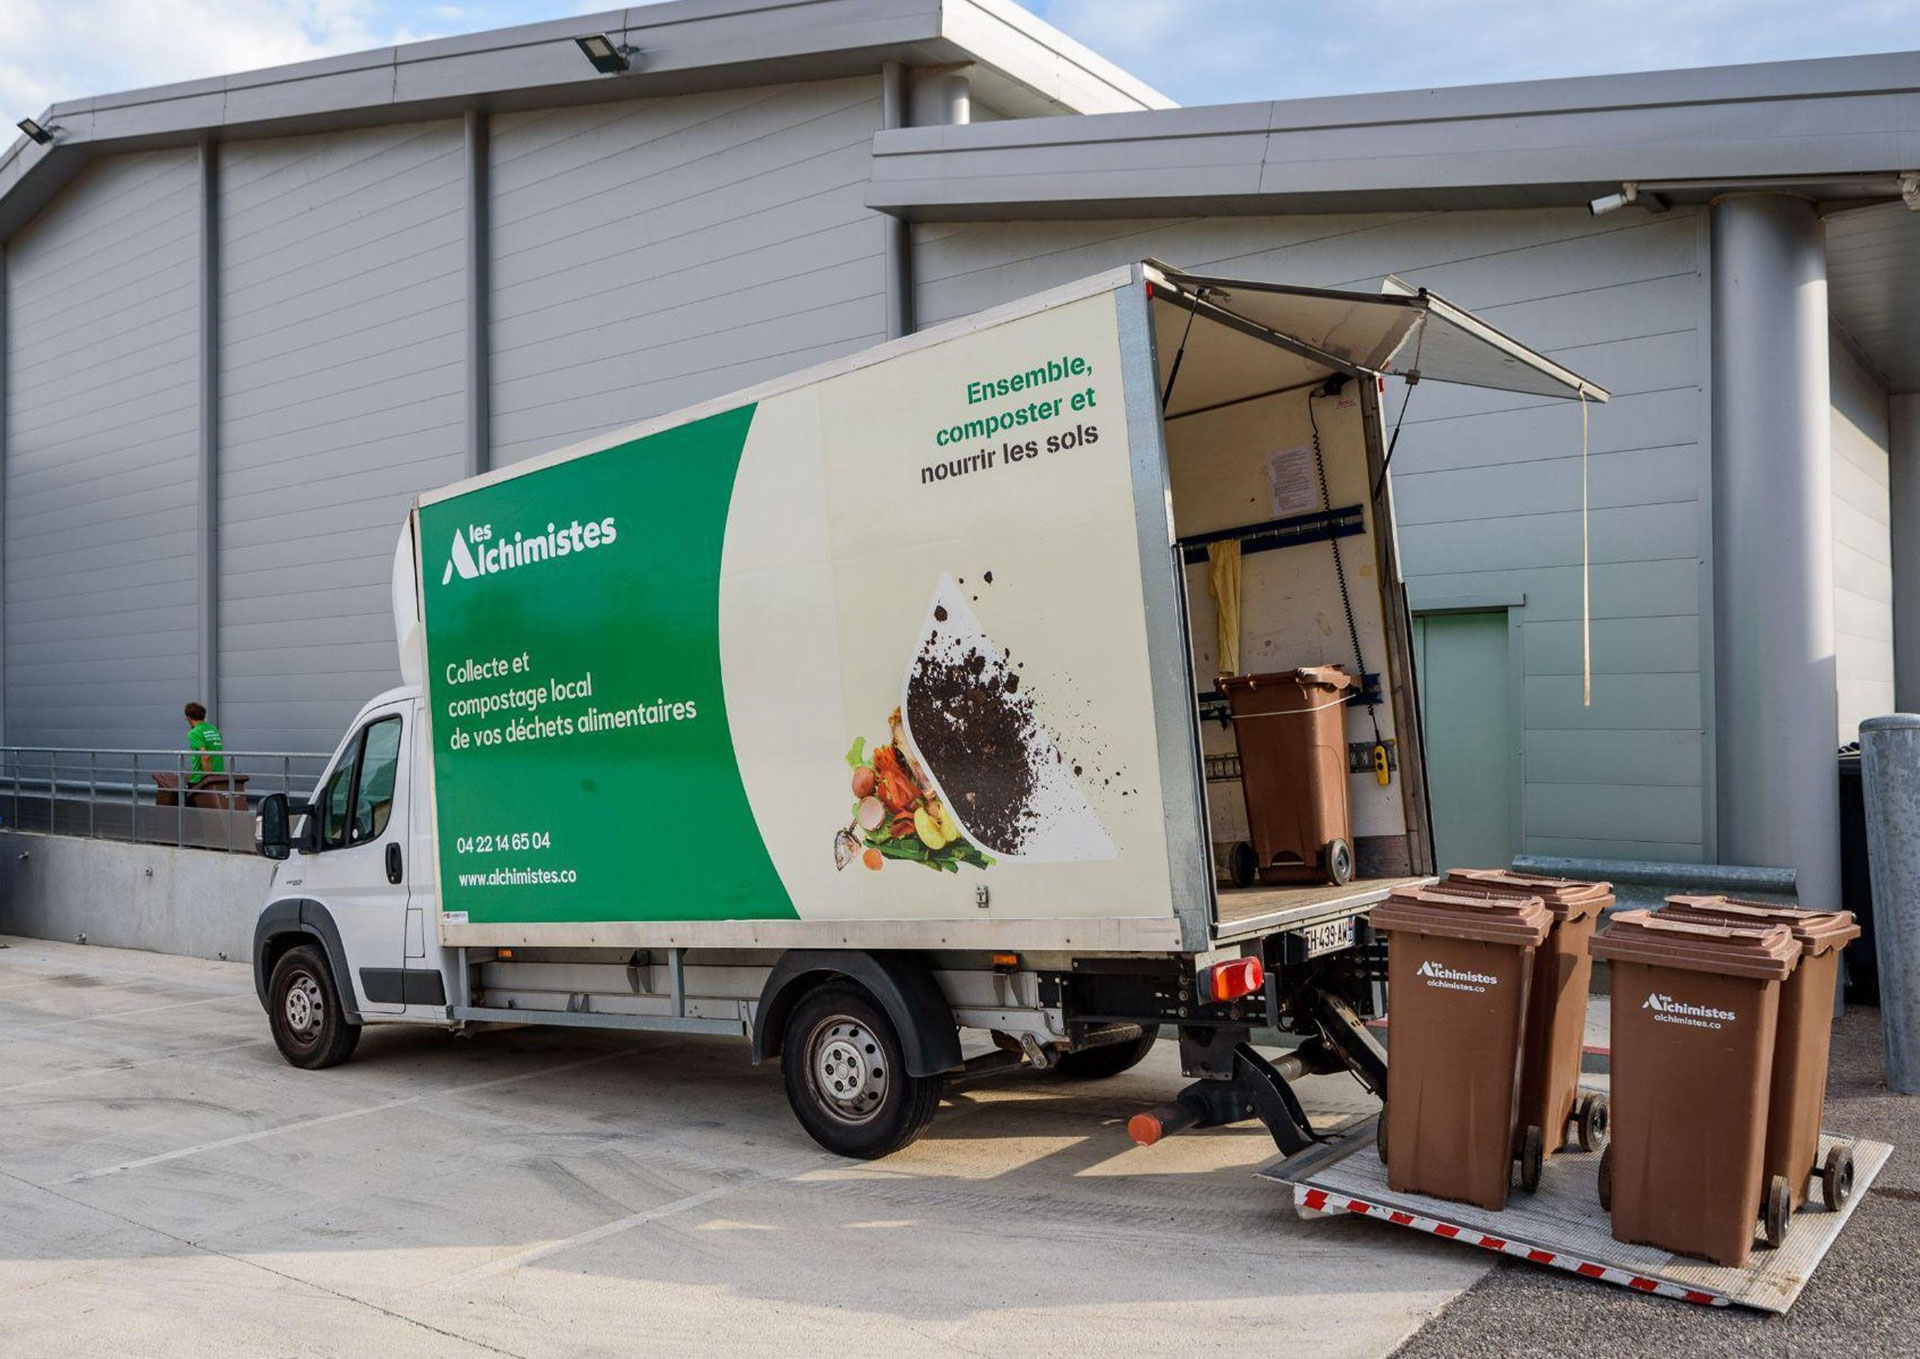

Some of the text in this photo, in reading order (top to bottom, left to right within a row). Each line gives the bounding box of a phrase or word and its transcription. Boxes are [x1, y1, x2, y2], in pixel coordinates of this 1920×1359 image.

[967, 356, 1092, 404] Ensemble,
[936, 387, 1096, 446] composter et
[921, 424, 1099, 484] nourrir les sols
[469, 524, 492, 543] les
[442, 517, 617, 585] Alchimistes
[446, 652, 530, 685] Collecte et
[449, 672, 592, 718] compostage local
[450, 698, 697, 750] de vos déchets alimentaires
[457, 832, 550, 853] 04 22 14 65 04
[459, 868, 577, 886] www.alchimistes.co
[1416, 960, 1497, 984] Alchimistes
[1431, 961, 1443, 969] les
[1427, 980, 1485, 993] alchimistes.co
[1658, 993, 1672, 1002] les
[1642, 992, 1736, 1020] Alchimistes
[1654, 1013, 1721, 1029] alchimistes.co
